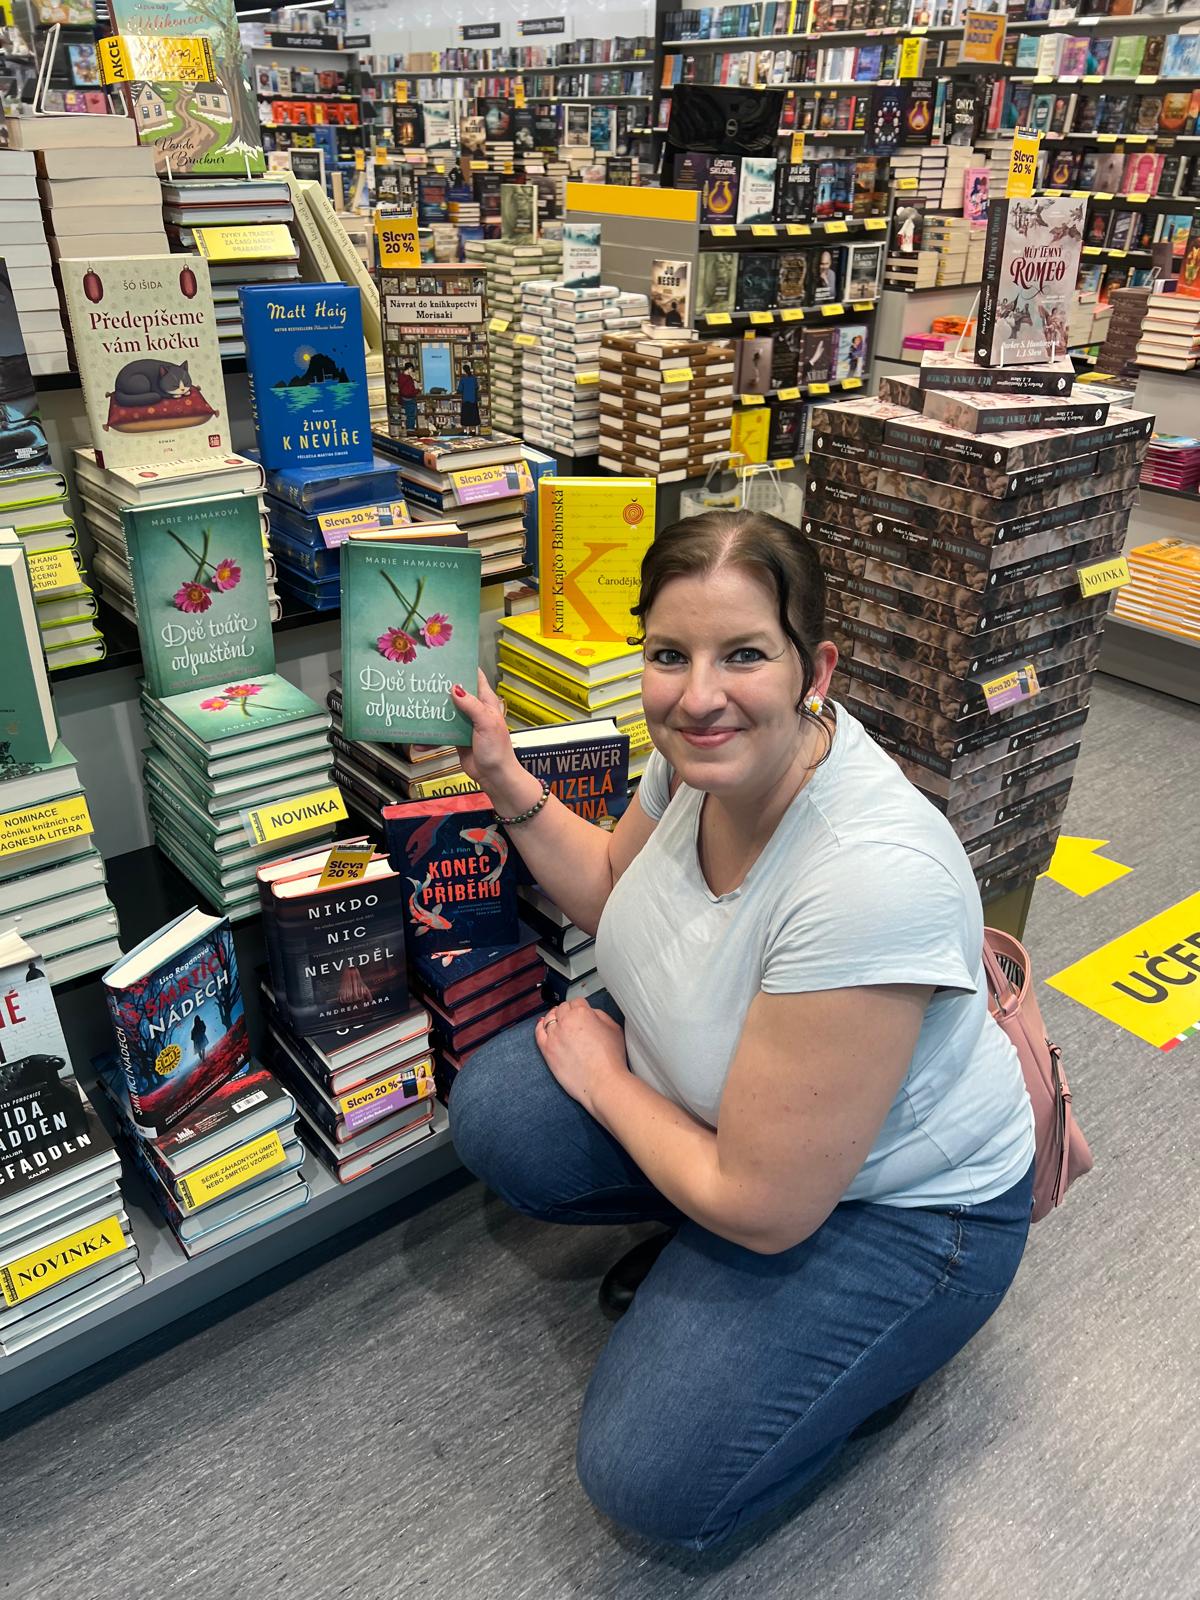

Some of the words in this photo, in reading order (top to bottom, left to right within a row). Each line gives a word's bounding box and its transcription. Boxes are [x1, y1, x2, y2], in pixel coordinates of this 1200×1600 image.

[108, 39, 125, 78] AKCE
[955, 99, 975, 111] ONYX
[155, 138, 194, 151] Vanda
[171, 151, 225, 167] Bruckner
[1013, 150, 1034, 163] Sleva
[1012, 163, 1023, 174] 20
[1024, 164, 1032, 175] %
[382, 231, 415, 242] Sleva
[385, 243, 400, 254] 20
[402, 242, 415, 253] %
[139, 279, 163, 290] IŠIDA
[1010, 257, 1066, 295] ROMEO
[266, 302, 306, 320] Matt
[315, 299, 347, 324] Haig
[390, 299, 416, 308] Návrat
[418, 300, 428, 308] do
[429, 299, 478, 310] knihkupectví
[416, 310, 453, 319] Morisaki
[88, 308, 205, 333] Předepíšeme
[102, 335, 141, 354] vám
[145, 331, 200, 352] kočku
[303, 419, 337, 432] ŽIVOT
[282, 435, 292, 450] K
[299, 427, 360, 449] NEVÍŘE
[460, 475, 482, 485] Sleva
[483, 472, 494, 480] 20
[151, 514, 182, 528] MARIE
[187, 507, 240, 522] HAMÁKOVÁ
[324, 517, 351, 528] Sleva
[351, 513, 364, 523] 20
[364, 511, 375, 521] %
[551, 489, 564, 550] Babinská
[37, 555, 58, 564] KANG
[46, 562, 62, 571] 2024
[365, 555, 398, 566] MARIE
[402, 558, 460, 570] HAMÁKOVÁ
[37, 571, 58, 580] CENU
[551, 554, 567, 596] Krajčo
[1084, 567, 1125, 588] NOVINKA
[552, 601, 564, 634] Karin
[161, 618, 207, 648] Dvě
[207, 612, 258, 638] tváře
[171, 636, 255, 676] odpuštění
[359, 665, 407, 692] Dvě
[409, 673, 456, 694] tváře
[1003, 679, 1012, 689] 20
[365, 693, 456, 727] odpuštění
[521, 757, 551, 776] TIM
[556, 749, 621, 773] WEAVER
[431, 779, 479, 799] NOVIN
[0, 826, 31, 840] očníku
[70, 811, 86, 823] cen
[4, 807, 59, 828] NOMINACE
[270, 799, 340, 829] NOVINKA
[0, 834, 46, 851] AGNESIA
[48, 823, 83, 840] LITERA
[327, 869, 345, 878] 20
[347, 869, 359, 878] %
[329, 860, 364, 869] Sleva
[428, 855, 490, 880] KONEC
[422, 878, 501, 905] PŘÍBĚHU
[308, 894, 378, 920] NIKDO
[327, 926, 367, 945] NIC
[304, 947, 395, 978] NEVIDĚL
[148, 968, 229, 1040] NÁDECH
[319, 1004, 359, 1018] ANDREA
[363, 996, 390, 1008] MARA
[346, 1093, 374, 1109] Sleva
[374, 1085, 387, 1097] 20
[387, 1080, 398, 1090] %
[0, 1111, 68, 1152] ADDEN
[0, 1133, 92, 1185] FADDEN
[206, 1178, 224, 1190] NEBO
[251, 1149, 278, 1167] VZOREC?
[220, 1151, 258, 1174] ZÁHADNÝCH
[18, 1233, 112, 1287] NOVINKA
